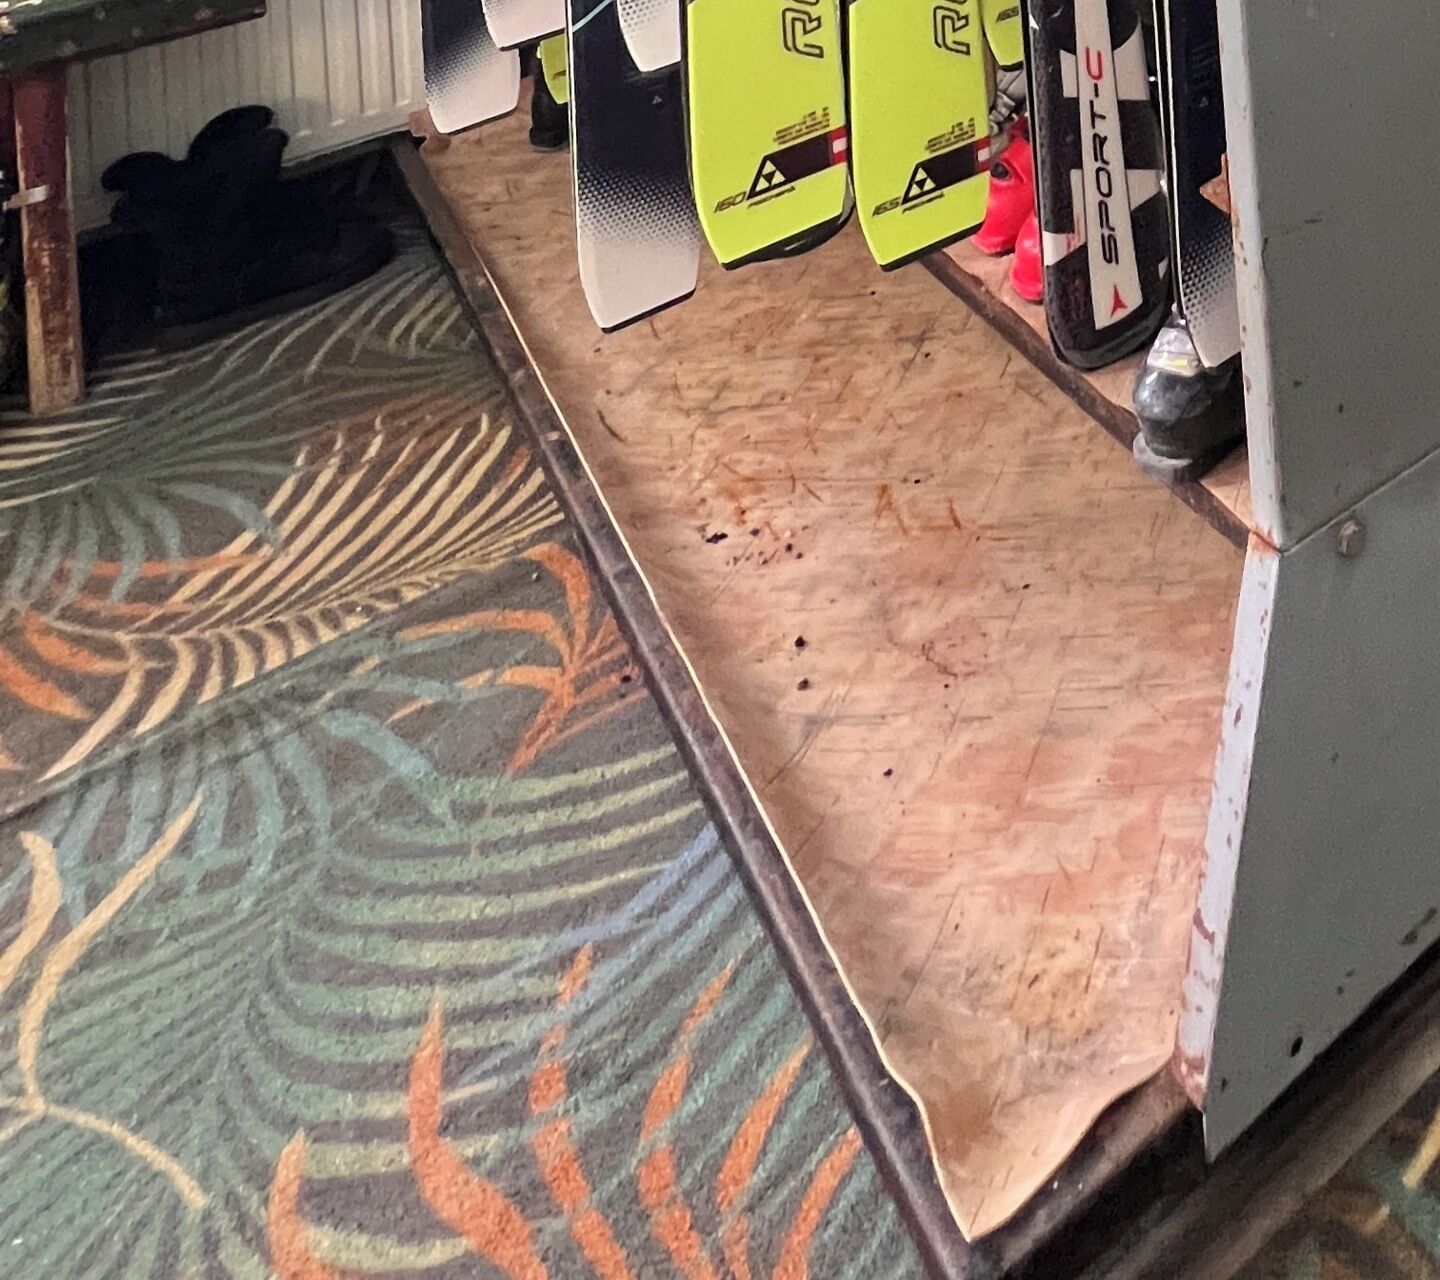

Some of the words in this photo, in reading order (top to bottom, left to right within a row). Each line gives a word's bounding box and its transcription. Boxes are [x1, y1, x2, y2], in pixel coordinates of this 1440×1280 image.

[1083, 44, 1121, 268] SPORT-C
[713, 190, 747, 214] 160
[871, 196, 902, 218] 165
